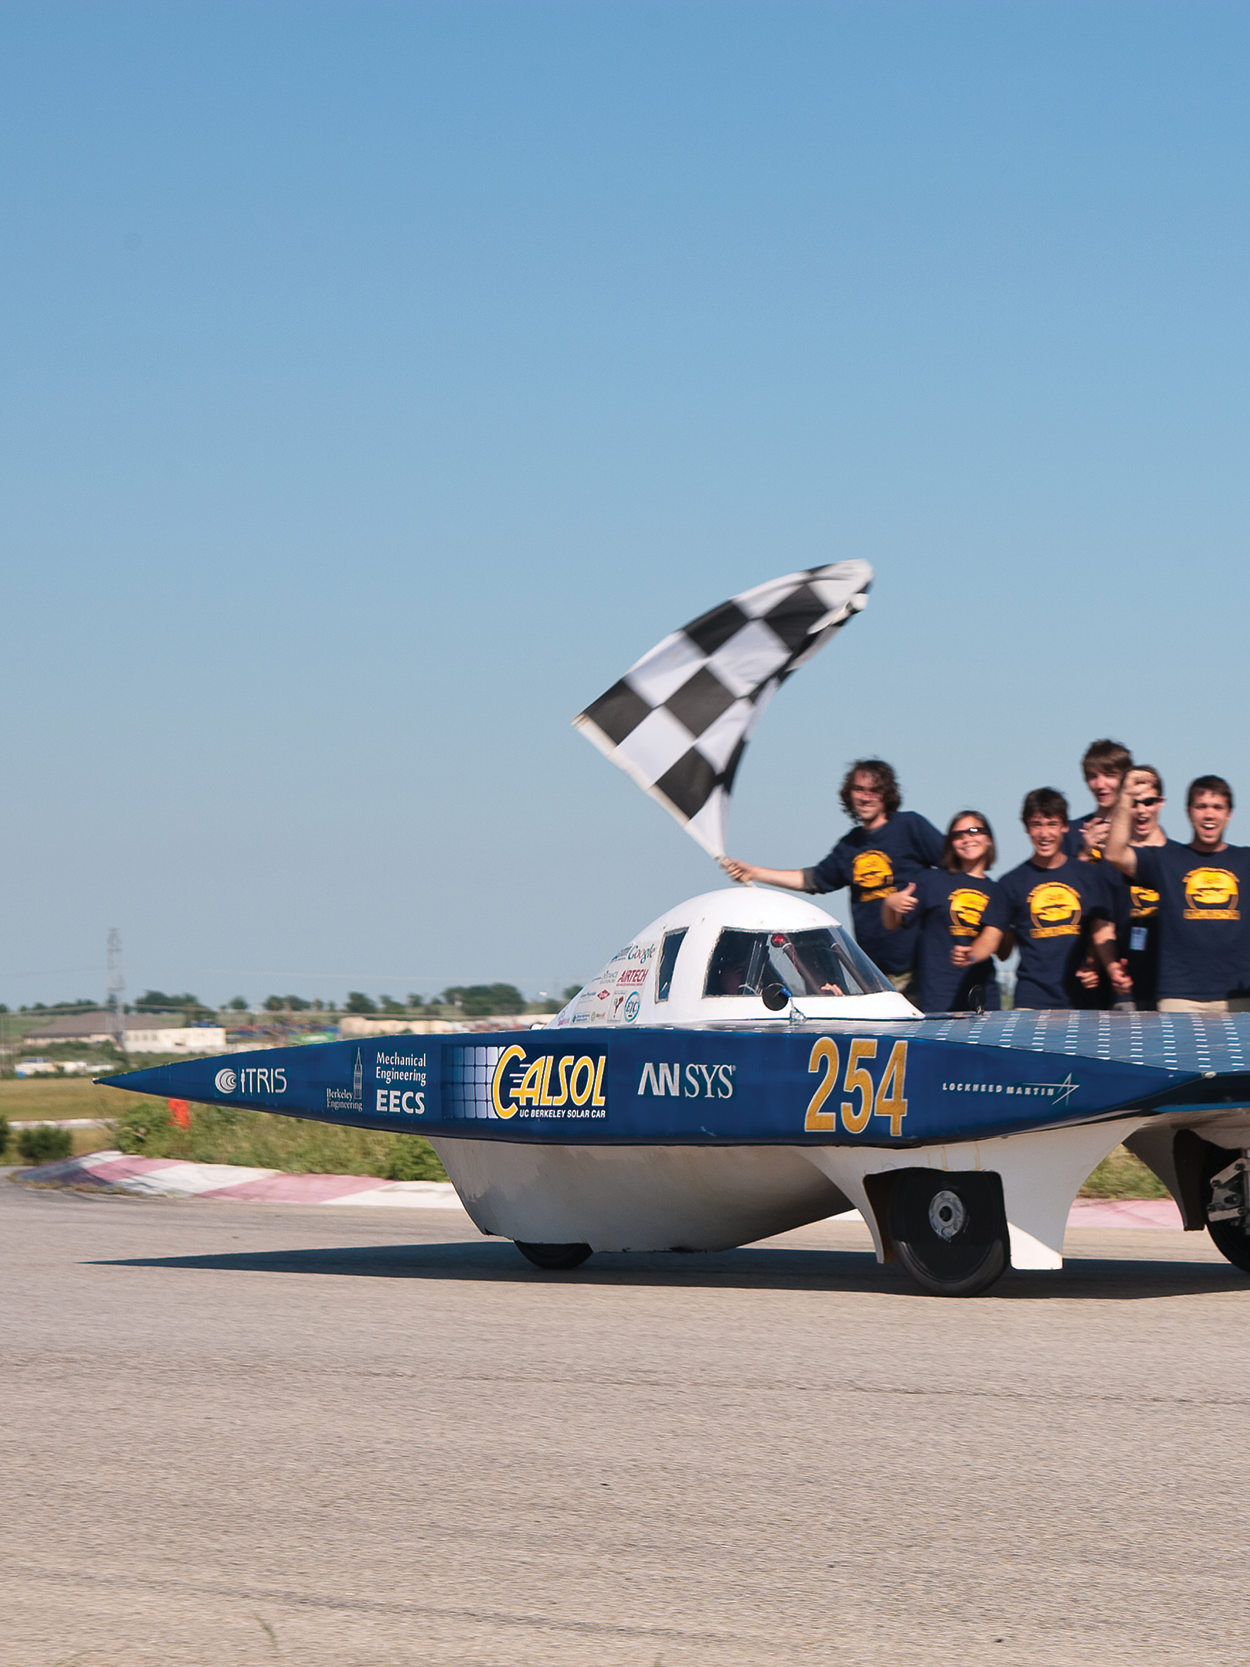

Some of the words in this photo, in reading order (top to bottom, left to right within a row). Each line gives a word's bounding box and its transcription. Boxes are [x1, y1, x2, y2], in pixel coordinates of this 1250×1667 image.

[617, 968, 649, 983] AIRTECH
[376, 1051, 427, 1067] Mechanical
[375, 1066, 427, 1087] Engineering
[492, 1044, 606, 1119] CALSOL
[804, 1037, 908, 1136] 254
[942, 1082, 1003, 1093] LOCKHEED
[1006, 1086, 1055, 1096] MARTIN
[326, 1087, 354, 1102] Berkeley
[376, 1089, 426, 1115] EECS
[326, 1100, 363, 1112] Engineering
[519, 1109, 530, 1118] UC
[530, 1109, 566, 1118] BERKELEY
[567, 1109, 590, 1119] SOLAR
[591, 1109, 606, 1119] CAR
